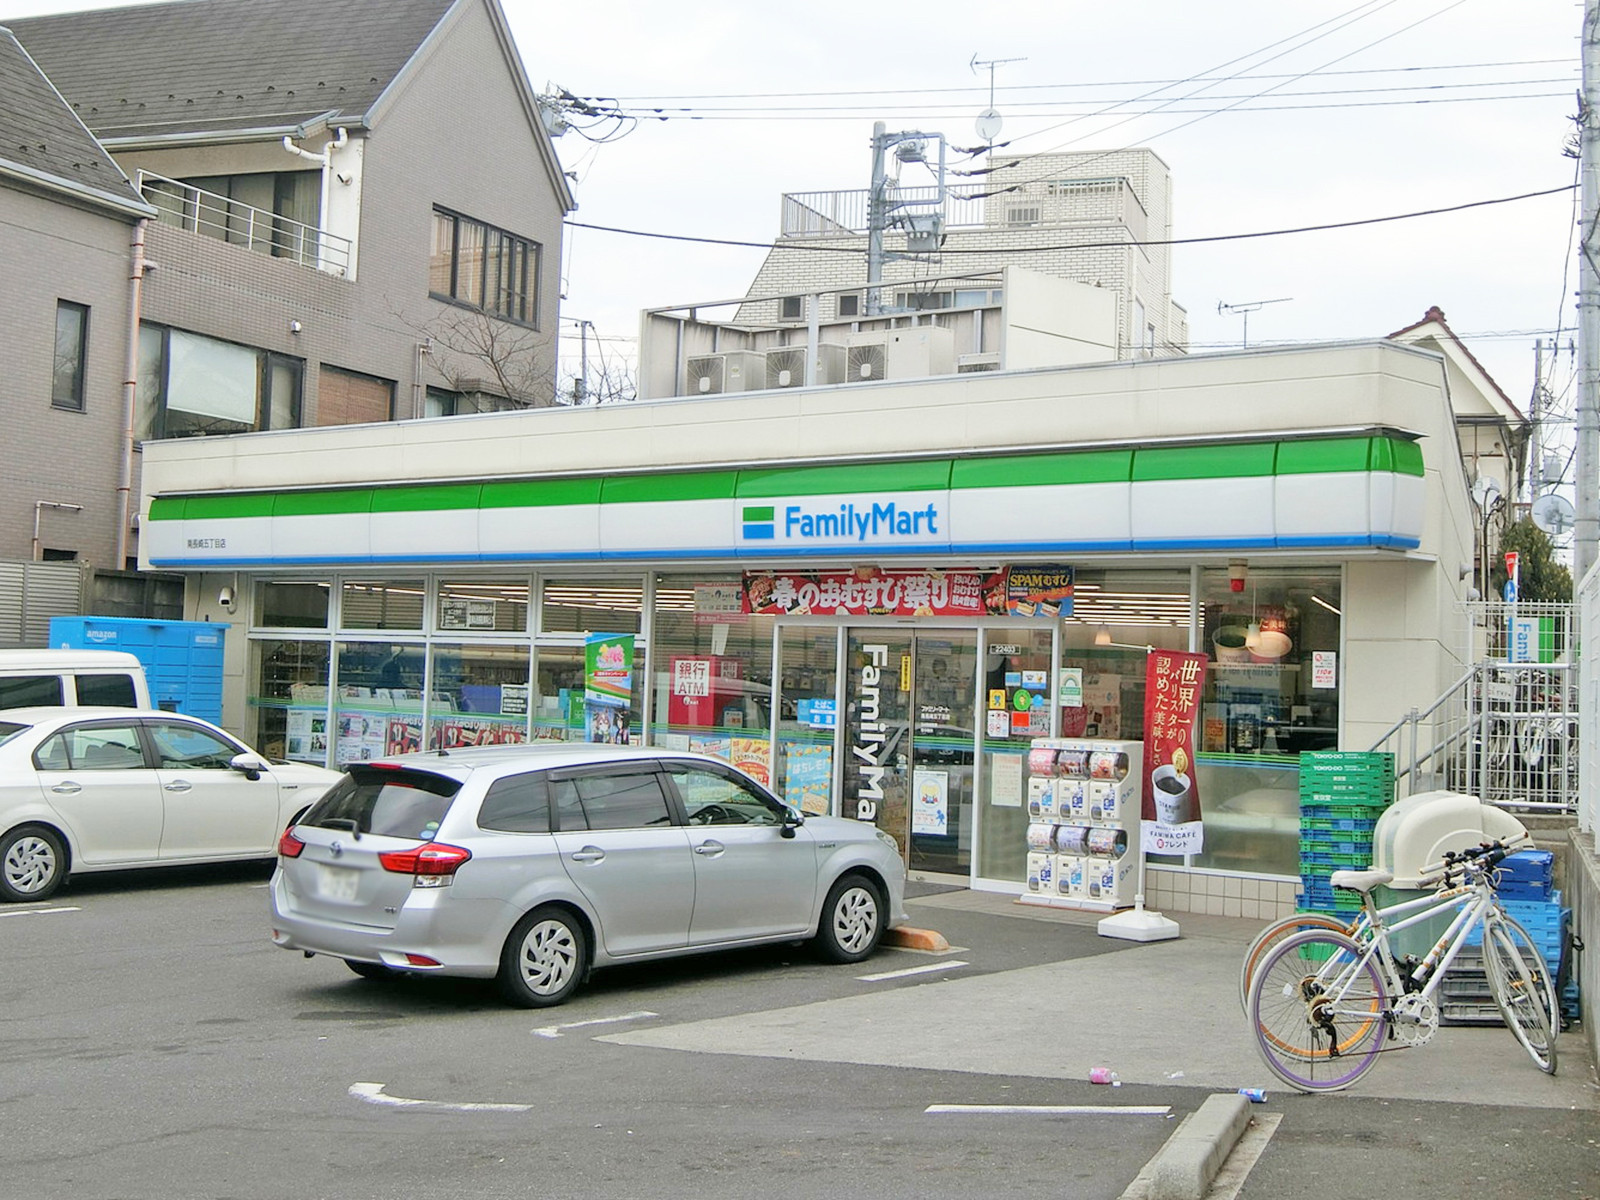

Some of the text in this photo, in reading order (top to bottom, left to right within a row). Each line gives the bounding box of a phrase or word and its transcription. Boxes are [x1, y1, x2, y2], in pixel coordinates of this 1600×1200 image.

[785, 502, 938, 541] FamilyMart
[769, 576, 949, 609] 春のおむすび祭り
[1010, 574, 1070, 587] SPAMむすび
[87, 630, 117, 641] amazon
[995, 645, 1015, 653] 22403
[1516, 622, 1532, 664] Fami
[679, 662, 705, 680] 銀行
[678, 682, 704, 695] ATM
[1166, 669, 1181, 739] バリスタが
[1177, 660, 1201, 745] 世界一の
[852, 644, 888, 827] FamilyMa
